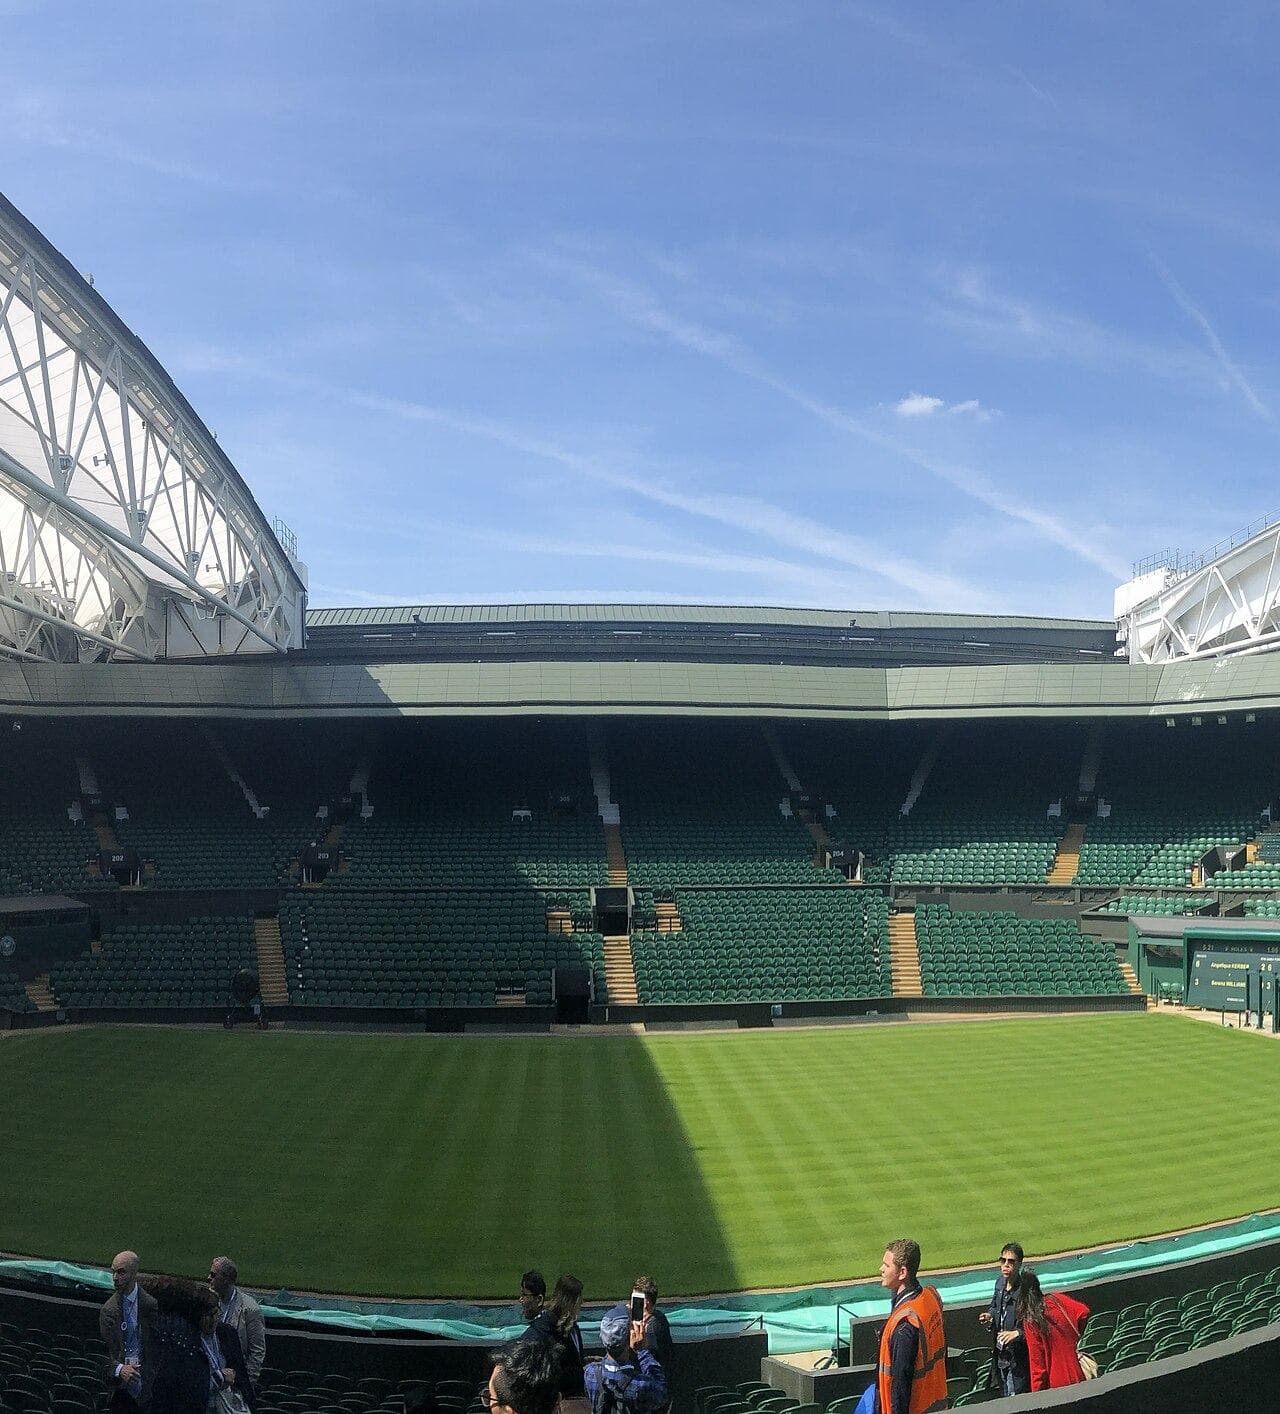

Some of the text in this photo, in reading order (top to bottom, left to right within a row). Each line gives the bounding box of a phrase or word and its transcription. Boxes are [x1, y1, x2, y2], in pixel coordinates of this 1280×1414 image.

[111, 854, 124, 862] 202
[1194, 978, 1199, 986] 3
[1266, 982, 1271, 990] 3
